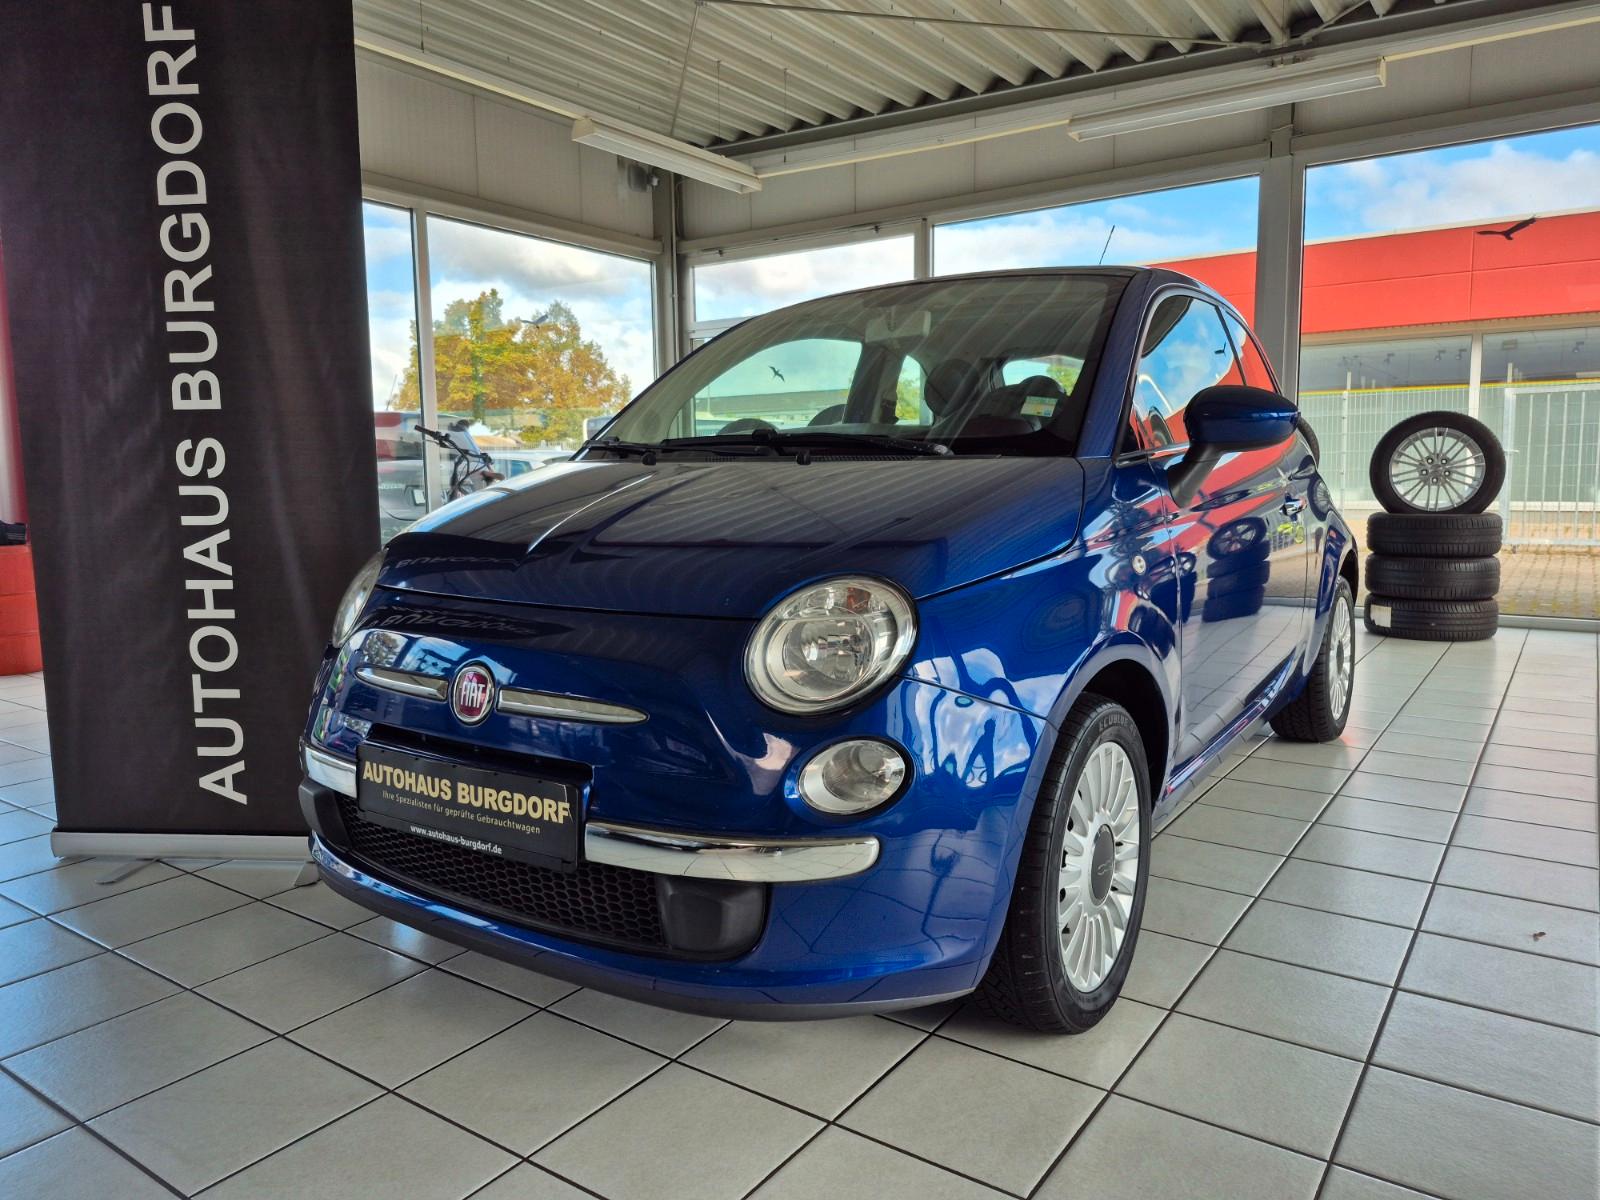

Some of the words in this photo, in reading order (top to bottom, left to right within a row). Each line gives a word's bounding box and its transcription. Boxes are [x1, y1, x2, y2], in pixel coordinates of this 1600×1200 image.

[142, 2, 222, 410] BURGDORF
[176, 437, 248, 805] AUTOHAUS
[460, 681, 486, 708] FIAT
[362, 760, 452, 801] AUTOHAUS
[457, 782, 570, 825] BURGDORF
[382, 790, 395, 801] Ihre
[395, 793, 432, 811] Spezialisten
[433, 803, 444, 813] für
[444, 806, 475, 821] geprüfte
[476, 812, 541, 834] Gebrauchtwagen
[410, 825, 503, 855] www.autohaus-burgdorf.de
